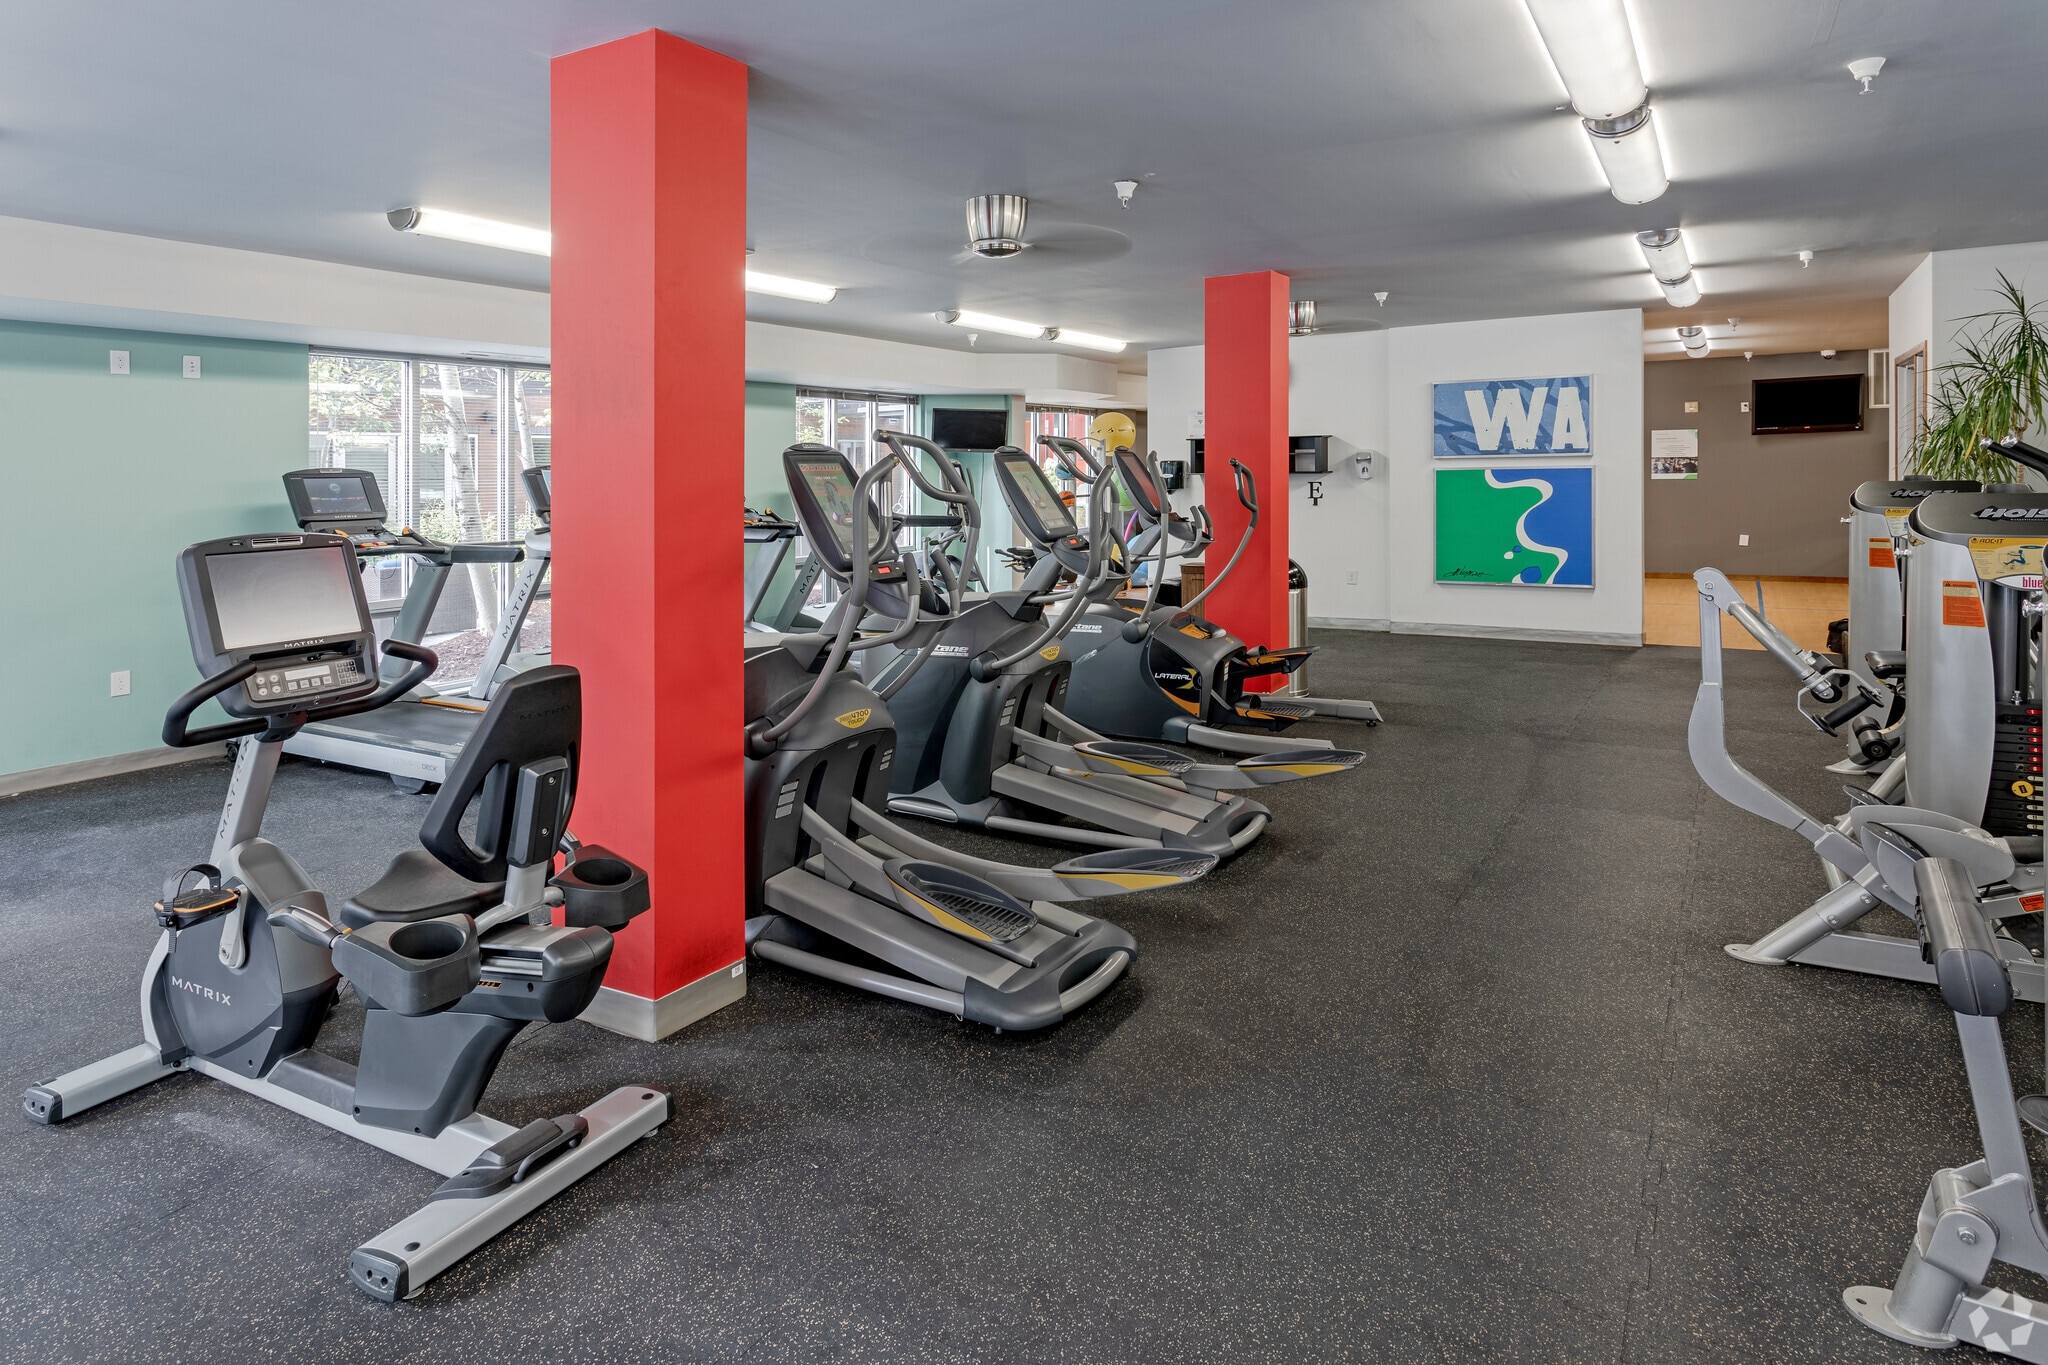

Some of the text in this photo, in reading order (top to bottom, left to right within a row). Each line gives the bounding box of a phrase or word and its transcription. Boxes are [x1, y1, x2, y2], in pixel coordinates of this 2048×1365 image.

[1464, 387, 1588, 450] WA
[1893, 489, 1955, 497] HOI
[501, 570, 534, 639] MATRIX
[284, 638, 325, 649] MATRIX
[933, 644, 969, 653] tane
[519, 704, 571, 721] MATRIX
[850, 709, 870, 719] 4700
[421, 763, 438, 772] DECK
[171, 975, 231, 1006] MATRIX
